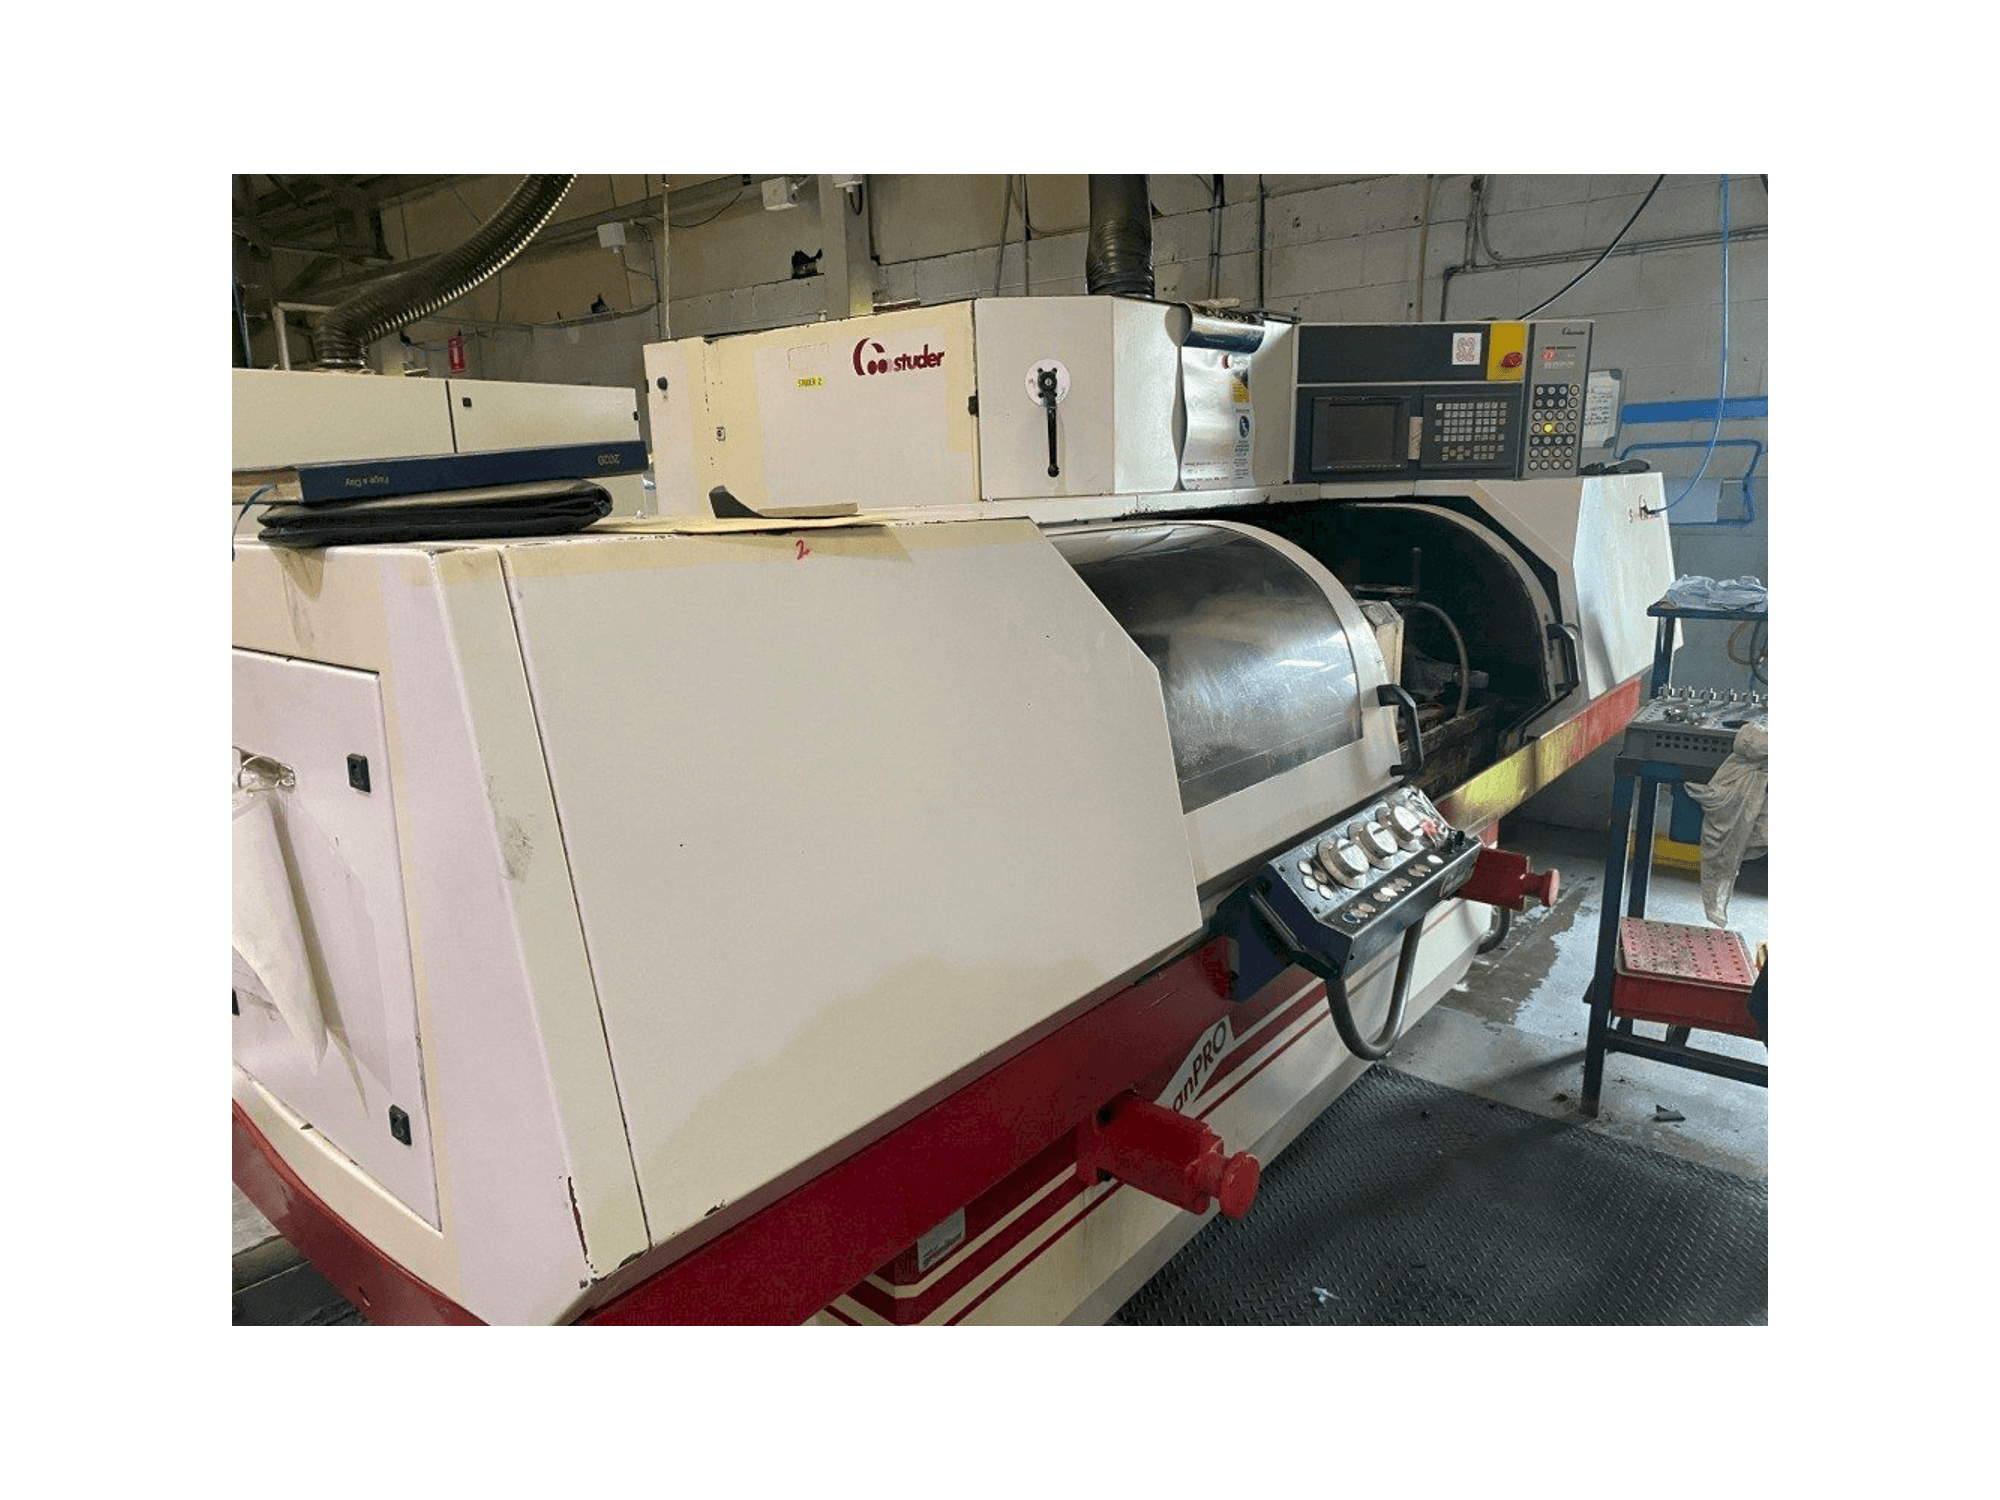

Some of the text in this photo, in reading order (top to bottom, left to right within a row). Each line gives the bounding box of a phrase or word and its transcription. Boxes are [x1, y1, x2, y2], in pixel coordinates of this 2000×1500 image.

[893, 343, 945, 372] studer
[597, 454, 620, 466] 2020
[346, 477, 362, 487] Day
[369, 475, 389, 485] Page
[795, 540, 810, 560] 2
